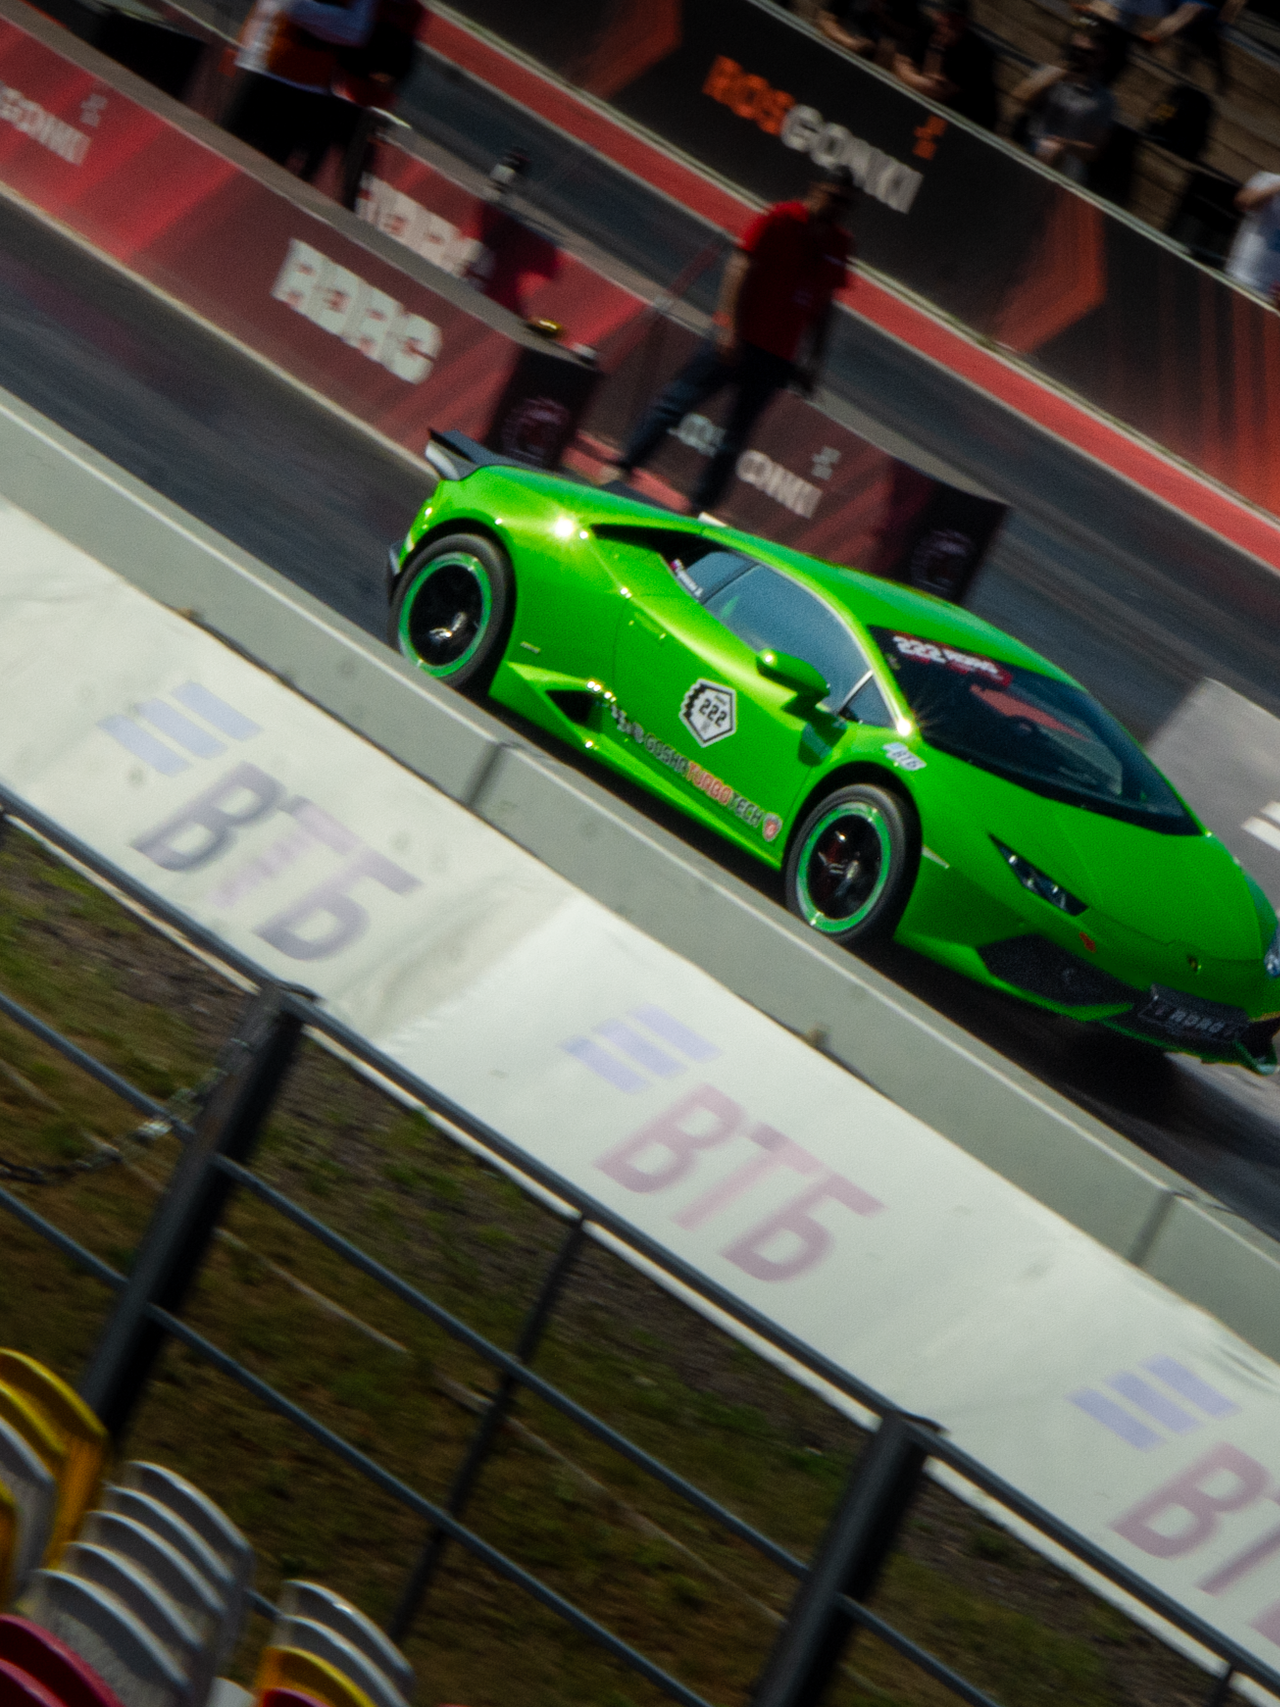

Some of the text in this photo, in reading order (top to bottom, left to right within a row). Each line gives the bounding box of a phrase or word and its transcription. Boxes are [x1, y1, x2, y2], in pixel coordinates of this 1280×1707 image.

[270, 237, 443, 385] RDRC
[698, 698, 728, 728] 222
[130, 761, 424, 962] ВТБ
[592, 1082, 887, 1282] ВТБ
